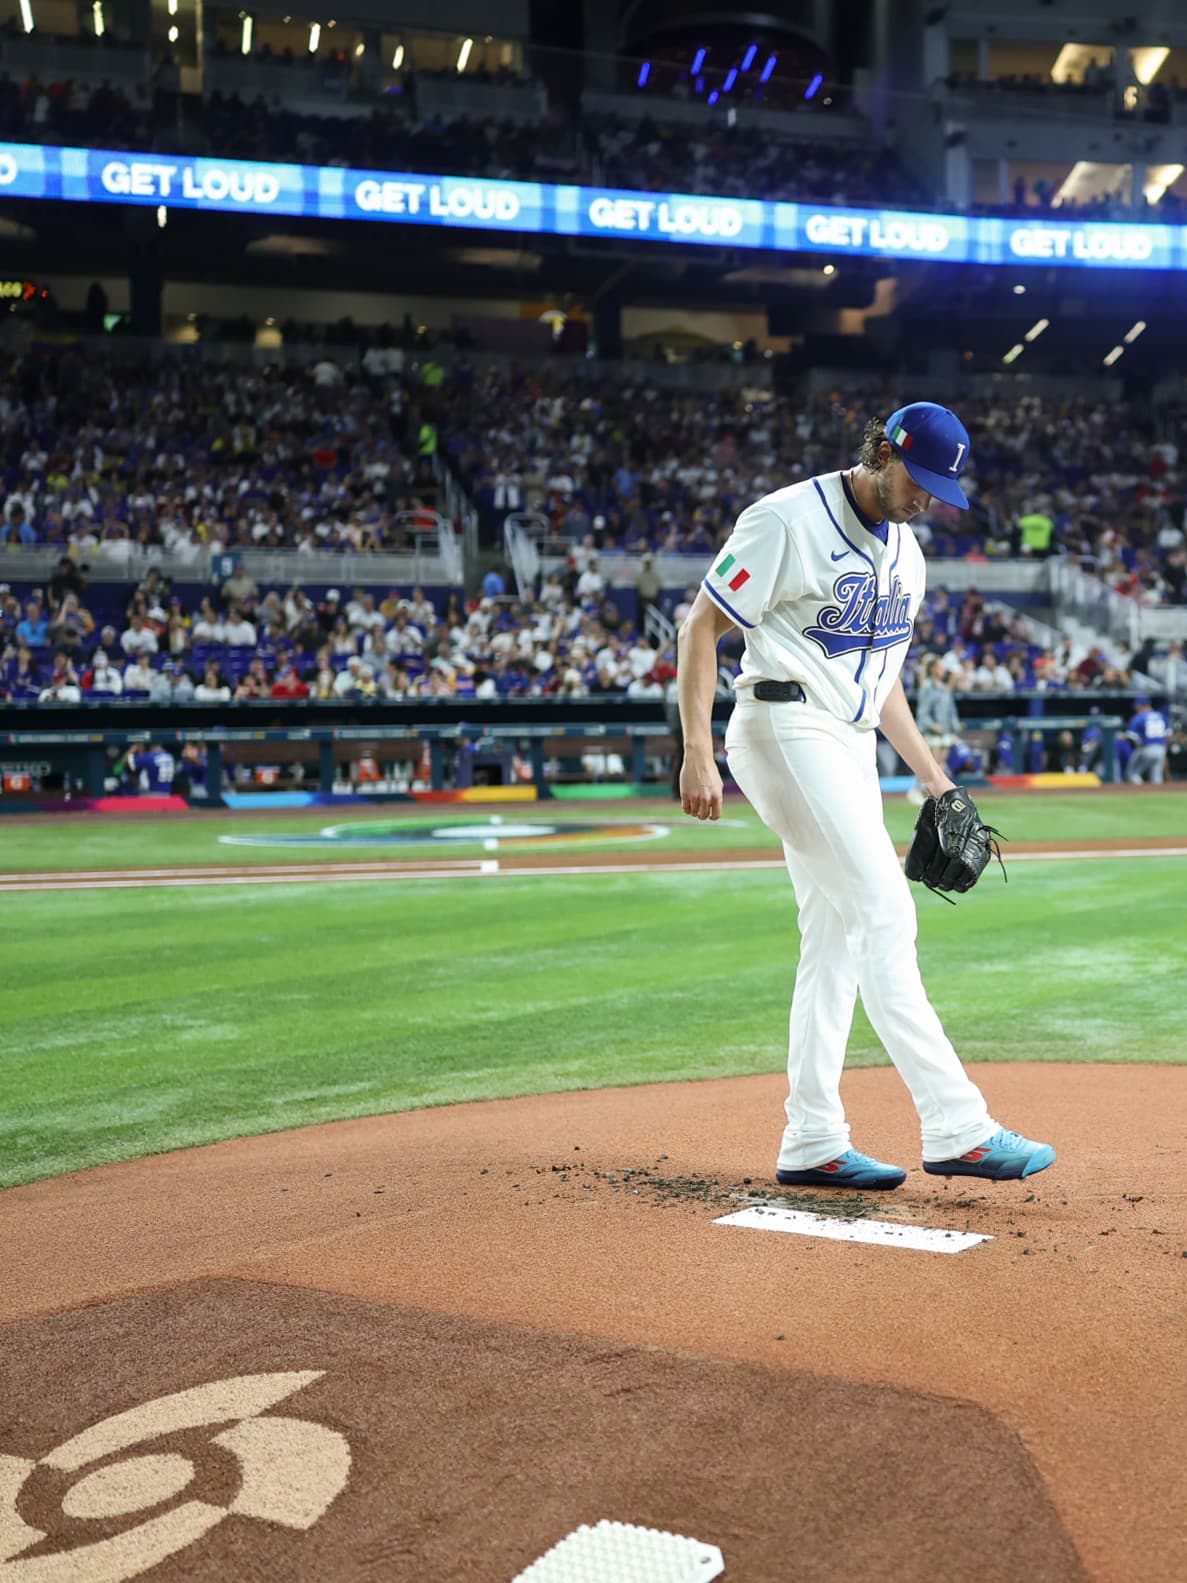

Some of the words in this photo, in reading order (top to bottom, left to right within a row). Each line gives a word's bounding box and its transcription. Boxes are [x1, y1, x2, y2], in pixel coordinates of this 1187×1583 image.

[102, 162, 177, 196] GET
[183, 168, 279, 202] LOUD
[355, 180, 425, 213] GET
[430, 185, 520, 220] LOUD
[589, 198, 655, 230] GET
[658, 203, 744, 236] LOUD
[806, 214, 869, 246] GET
[869, 219, 950, 252] LOUD
[1010, 226, 1071, 257] GET
[1073, 230, 1154, 260] LOUD
[949, 442, 966, 472] I
[817, 571, 911, 635] Italia
